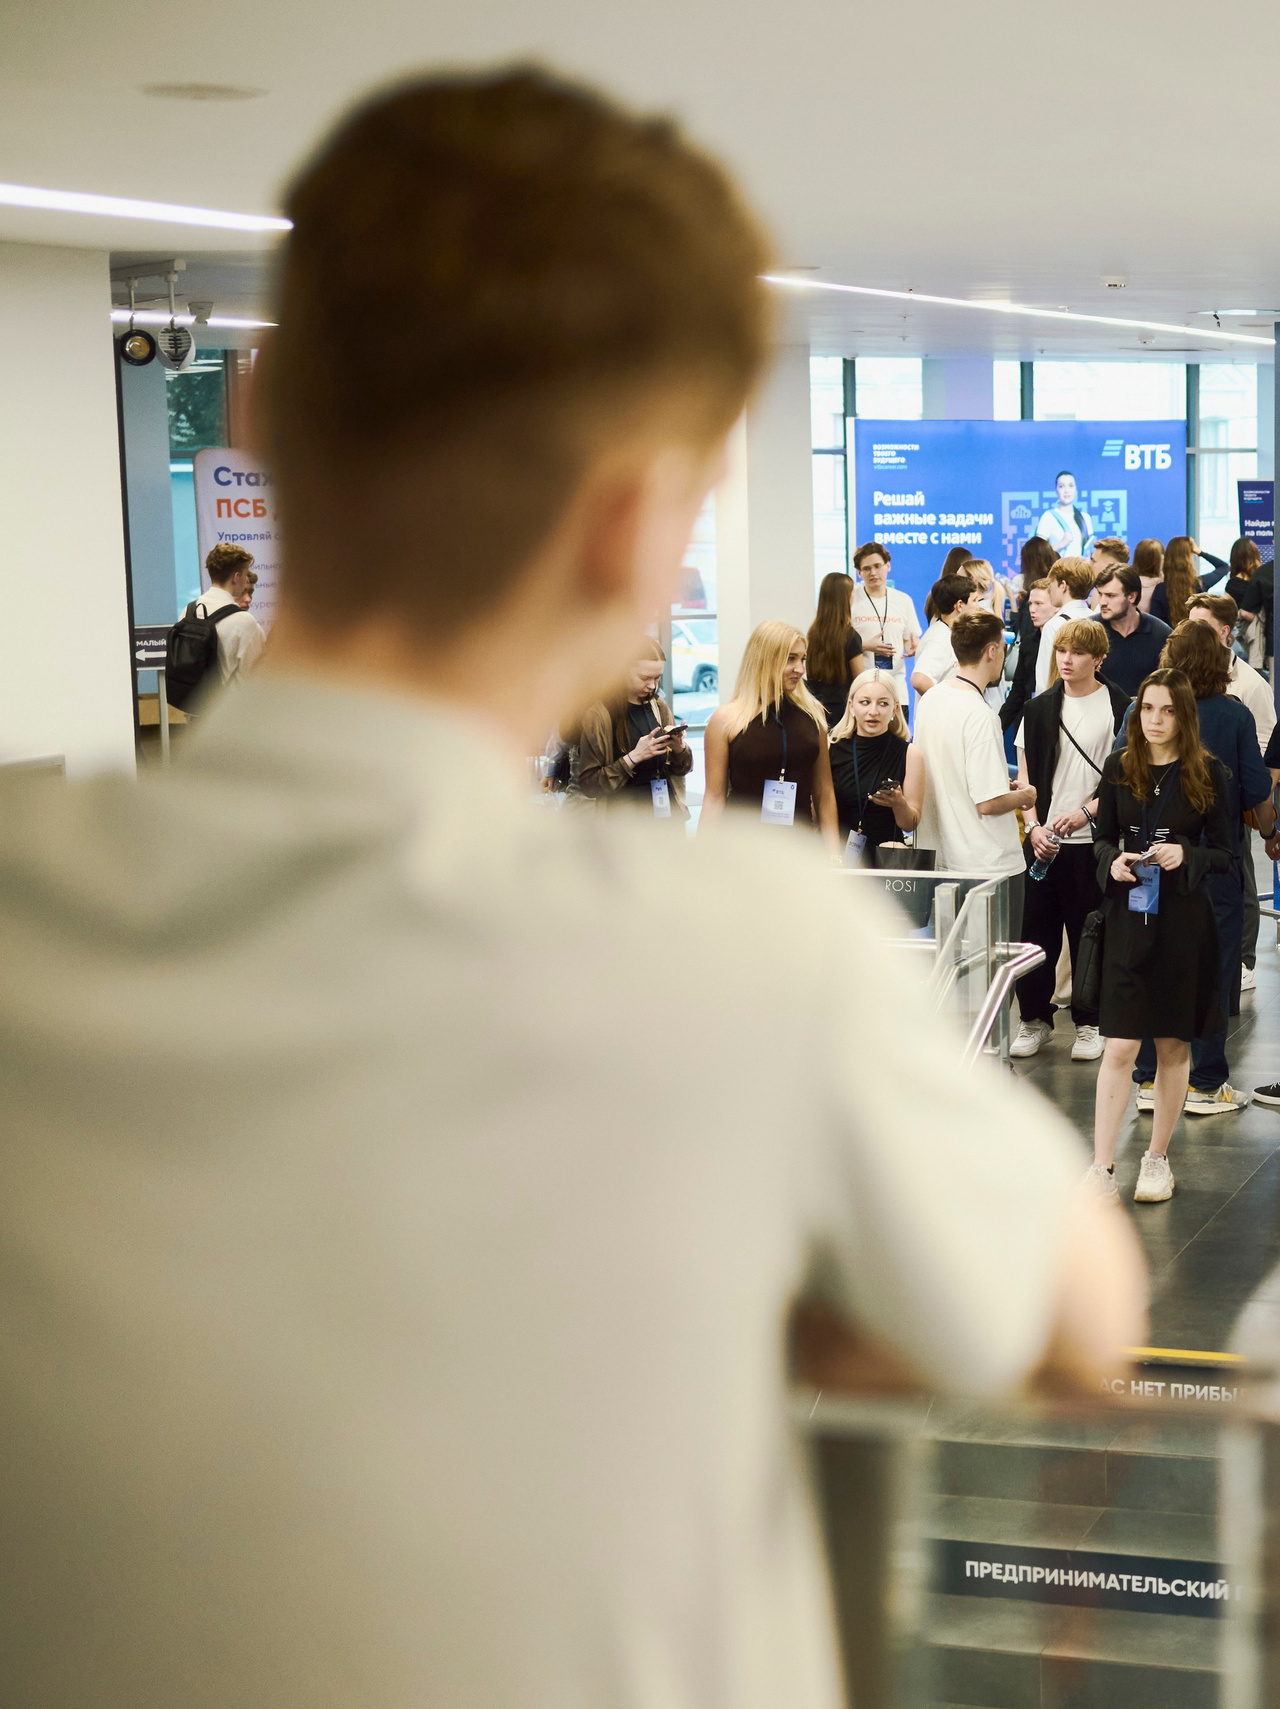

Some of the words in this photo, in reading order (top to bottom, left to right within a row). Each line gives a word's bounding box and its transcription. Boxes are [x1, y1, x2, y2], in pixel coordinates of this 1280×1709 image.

[1125, 444, 1171, 469] ВТБ
[873, 491, 925, 506] Решай
[216, 498, 267, 518] ПСБ
[874, 514, 936, 525] важные
[939, 514, 993, 527] задачи
[218, 532, 272, 541] Управляй
[874, 533, 928, 544] вместе
[930, 533, 939, 544] с
[941, 533, 982, 544] нами
[885, 879, 916, 892] ROSI
[1130, 1380, 1166, 1398] НЕТ
[1170, 1383, 1247, 1402] ПРИБЫ
[965, 1560, 1229, 1600] ПРЕДПРИНИМАТЕЛЬСКИЙ
